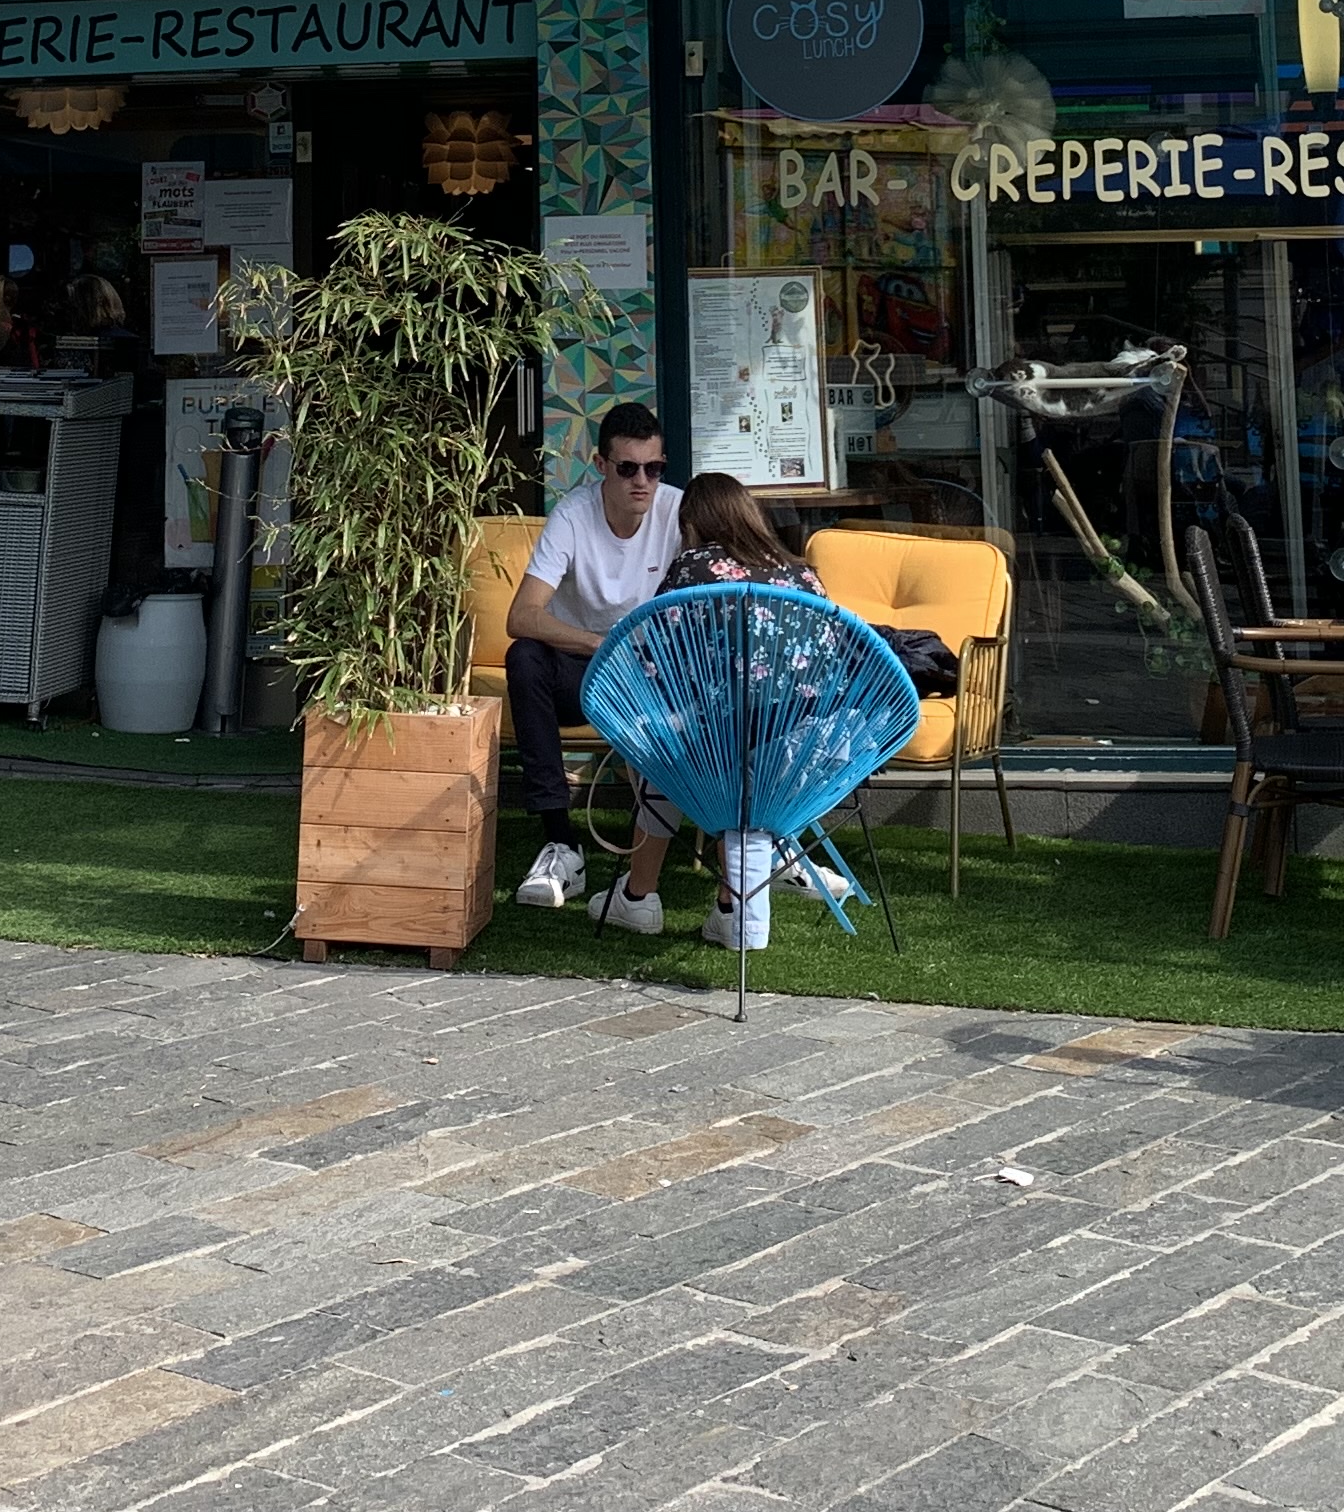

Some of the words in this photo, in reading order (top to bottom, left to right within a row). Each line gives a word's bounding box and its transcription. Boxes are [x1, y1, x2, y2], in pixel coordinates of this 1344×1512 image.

[802, 37, 855, 59] LUNCH
[159, 186, 194, 198] mots
[829, 389, 854, 405] BAR
